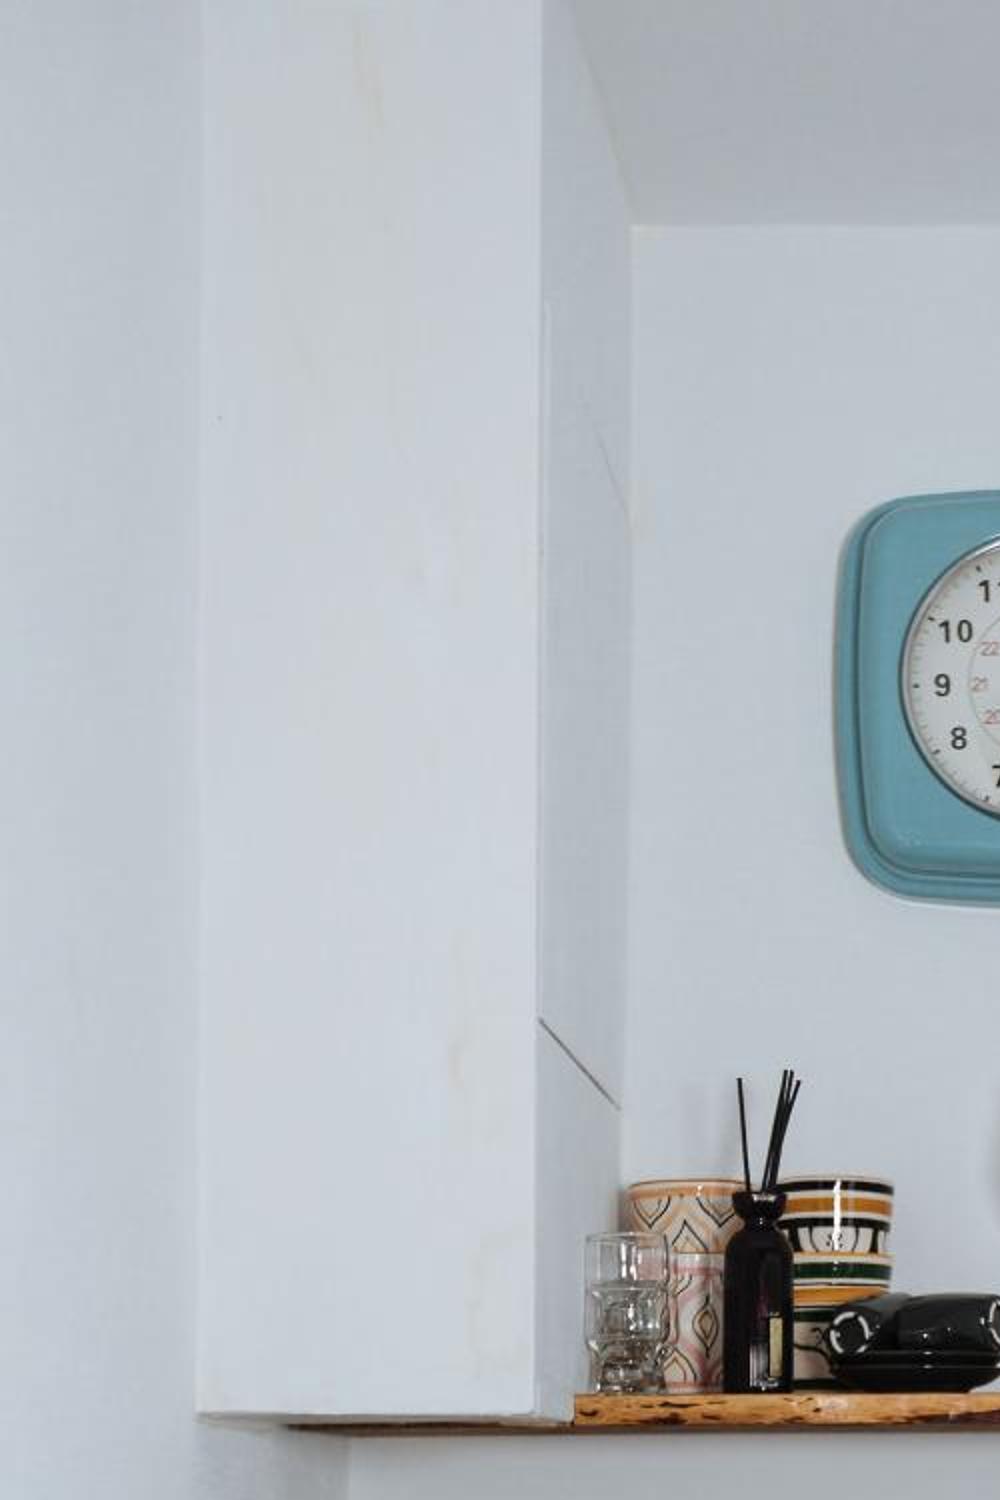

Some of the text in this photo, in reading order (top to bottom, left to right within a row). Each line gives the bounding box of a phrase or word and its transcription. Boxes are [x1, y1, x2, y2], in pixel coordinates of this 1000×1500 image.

[939, 620, 972, 642] 10
[981, 641, 1000, 656] 22
[935, 674, 950, 696] 9
[951, 728, 967, 749] 8
